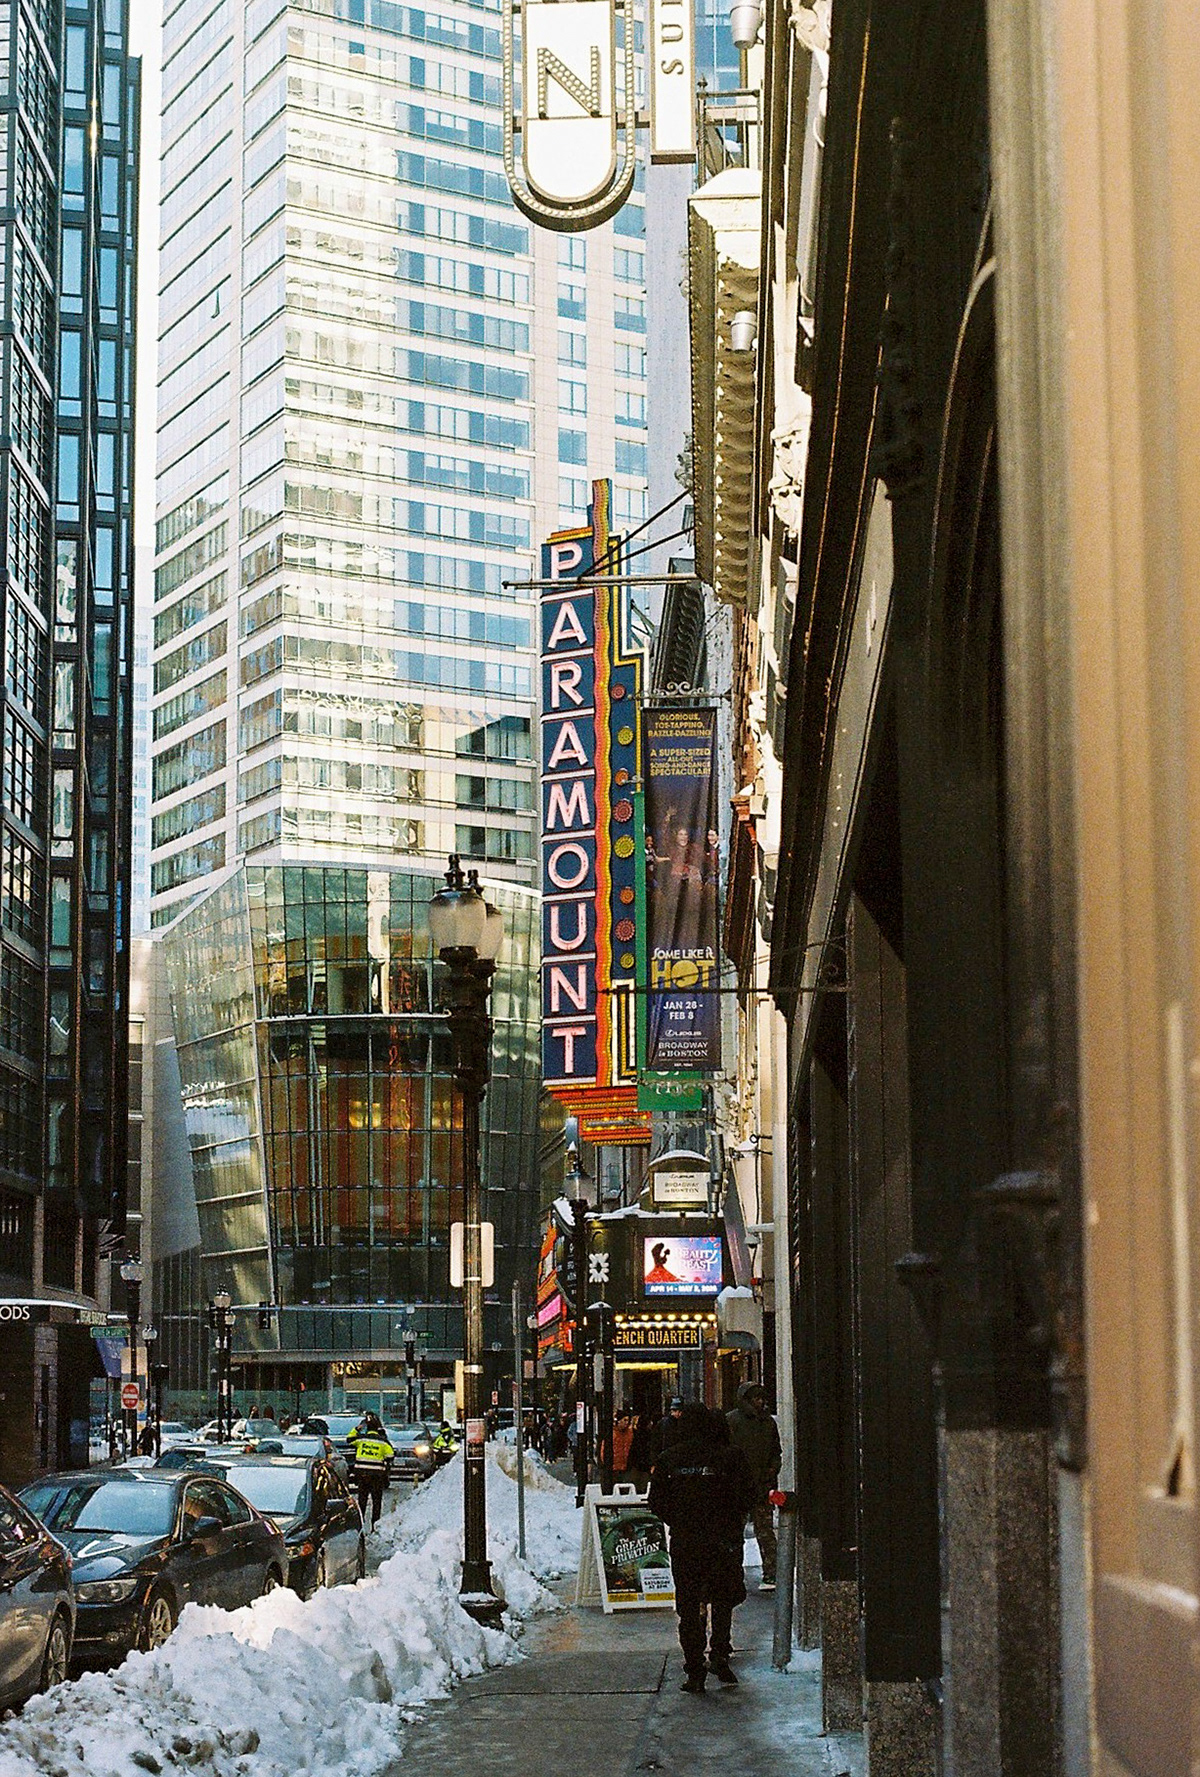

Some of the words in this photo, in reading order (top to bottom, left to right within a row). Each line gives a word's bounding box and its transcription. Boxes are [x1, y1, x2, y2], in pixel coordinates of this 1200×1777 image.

[658, 713, 701, 721] GLORIOUS,
[655, 721, 705, 729] TOE-TAPPING,
[650, 749, 657, 757] A
[659, 748, 711, 756] SUPER-SIZED
[547, 541, 591, 1076] PARAMOUNT
[651, 947, 680, 960] SOME
[682, 949, 704, 959] LIKE
[651, 960, 716, 989] HOT
[663, 1001, 683, 1010] JAN
[685, 1001, 698, 1010] 28
[669, 1012, 685, 1020] FEB
[687, 1011, 694, 1020] 8
[648, 1330, 698, 1344] QUARTER
[615, 1537, 648, 1554] GREAT
[611, 1542, 660, 1565] PRIVATION
